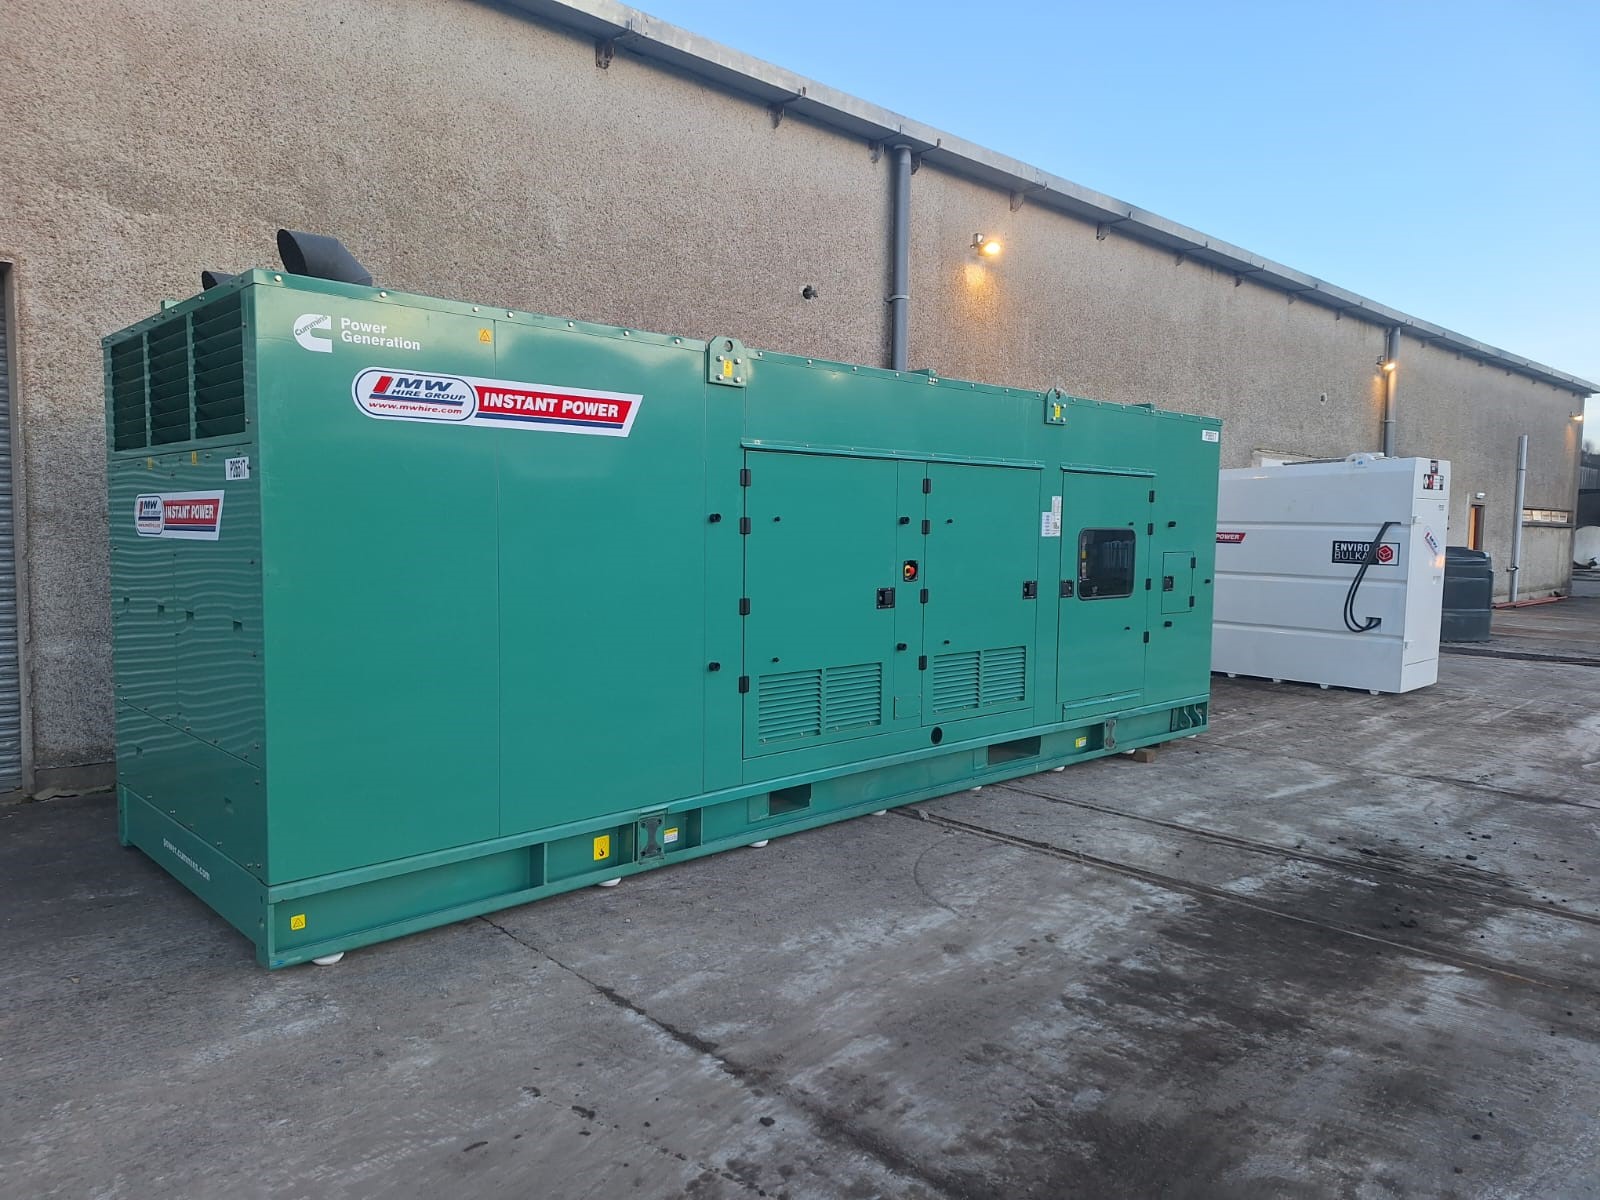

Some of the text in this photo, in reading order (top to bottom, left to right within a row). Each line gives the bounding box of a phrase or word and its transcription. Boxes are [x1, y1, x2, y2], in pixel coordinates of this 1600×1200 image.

[341, 317, 387, 334] Power
[341, 330, 421, 350] Generation
[395, 377, 453, 392] MW
[391, 388, 466, 401] HIRE GROUP
[368, 402, 463, 415] www.mwhire.com
[483, 392, 619, 418] INSTANT POWER
[144, 500, 157, 509] MW
[165, 505, 190, 519] INSTANT
[191, 504, 214, 519] POWER
[1335, 542, 1370, 552] ENVIRO
